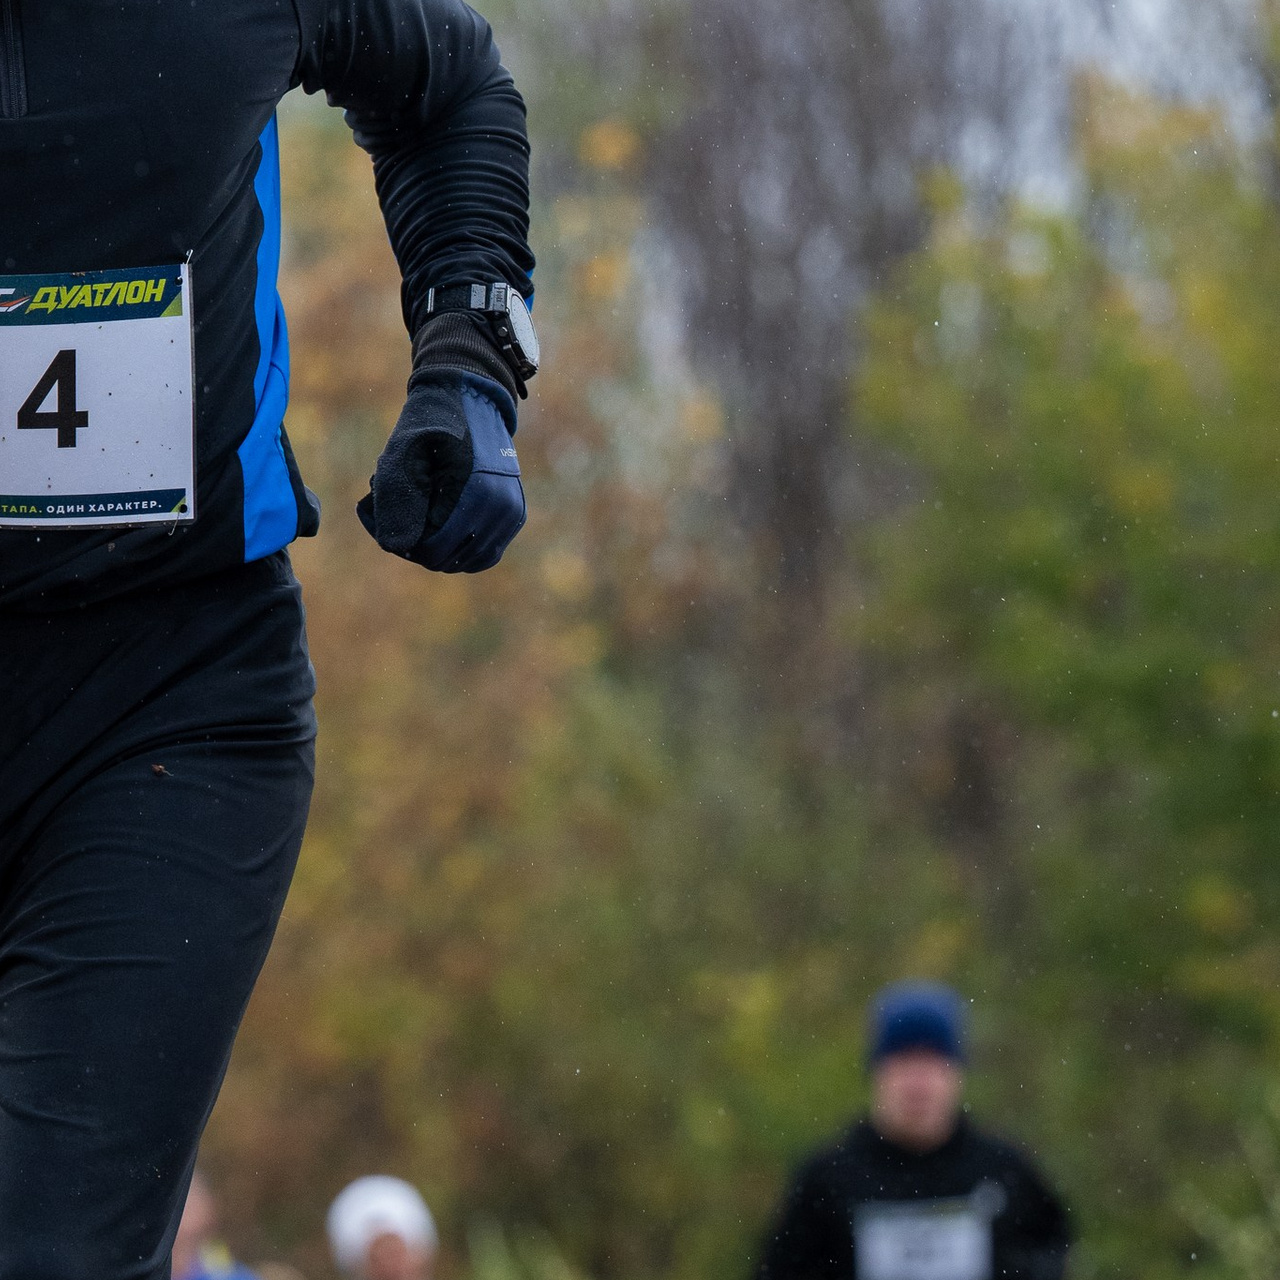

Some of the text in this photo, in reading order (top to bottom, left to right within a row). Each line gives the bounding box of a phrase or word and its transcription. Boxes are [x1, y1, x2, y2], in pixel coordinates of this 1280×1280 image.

[24, 278, 166, 314] ДУАТЛОН
[46, 503, 85, 514] ОДИН
[89, 500, 162, 513] ХАРАКТЕР.
